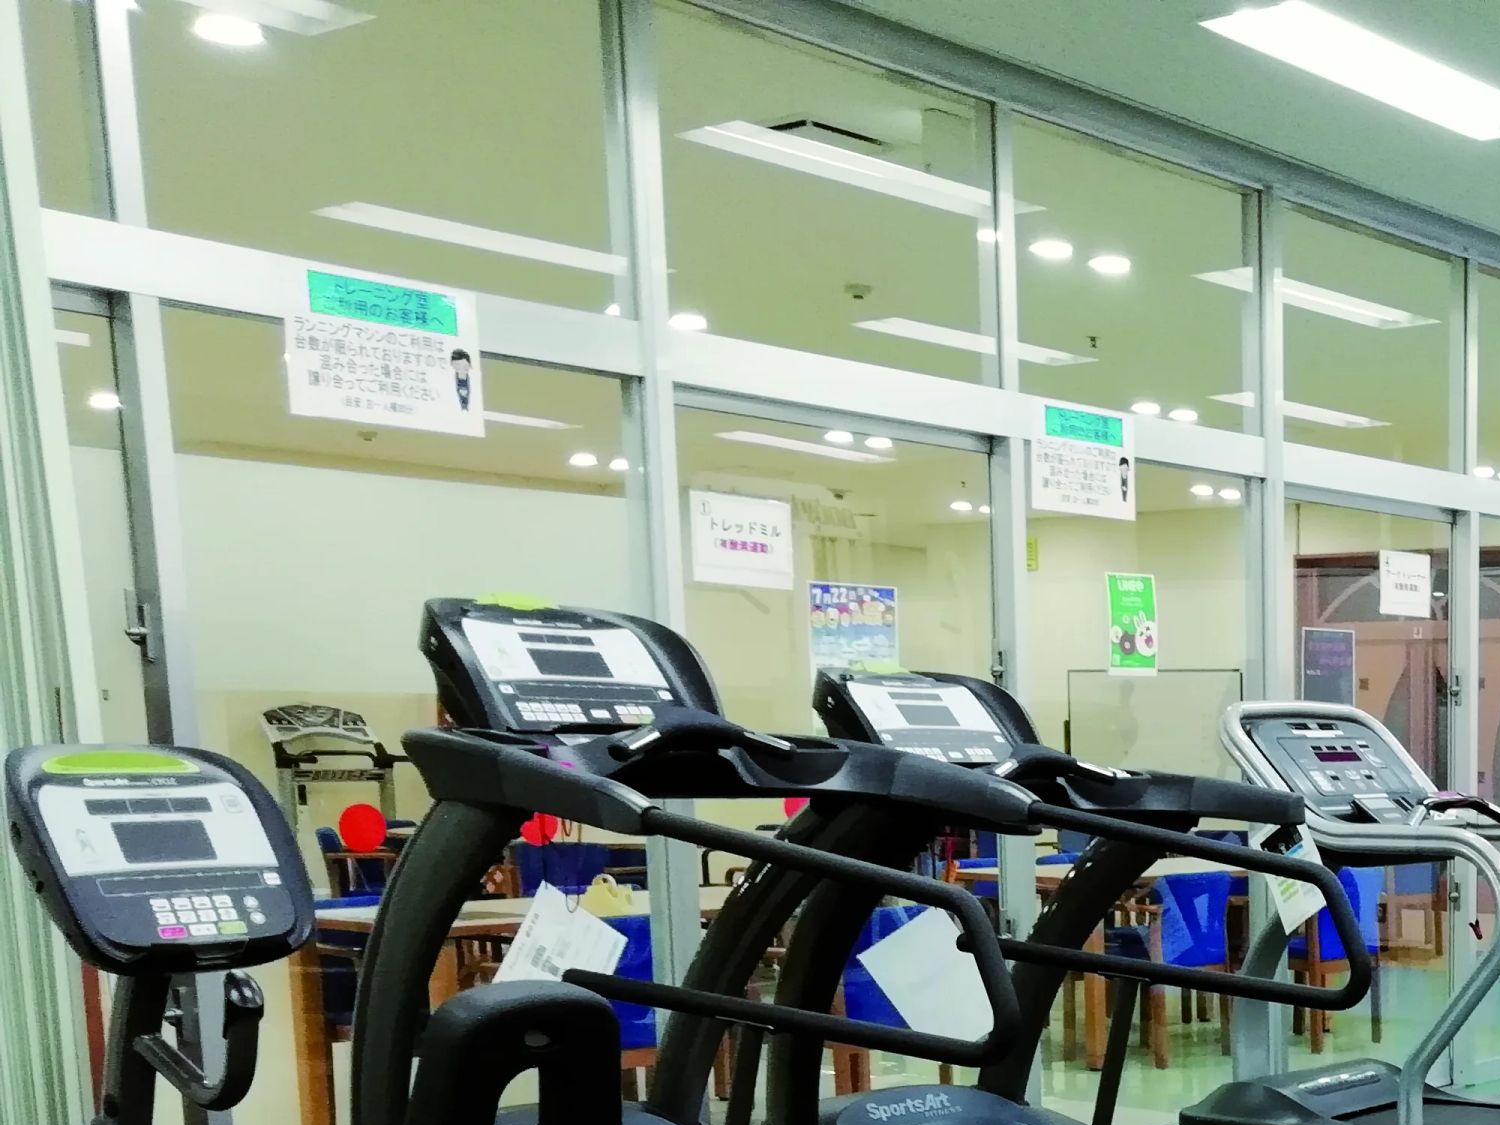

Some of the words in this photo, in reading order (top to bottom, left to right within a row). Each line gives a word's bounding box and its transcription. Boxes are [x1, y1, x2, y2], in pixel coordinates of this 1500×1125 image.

[709, 517, 782, 538] トレッドミル
[865, 1092, 951, 1121] SportsArt
[924, 1105, 963, 1118] FITNESS
